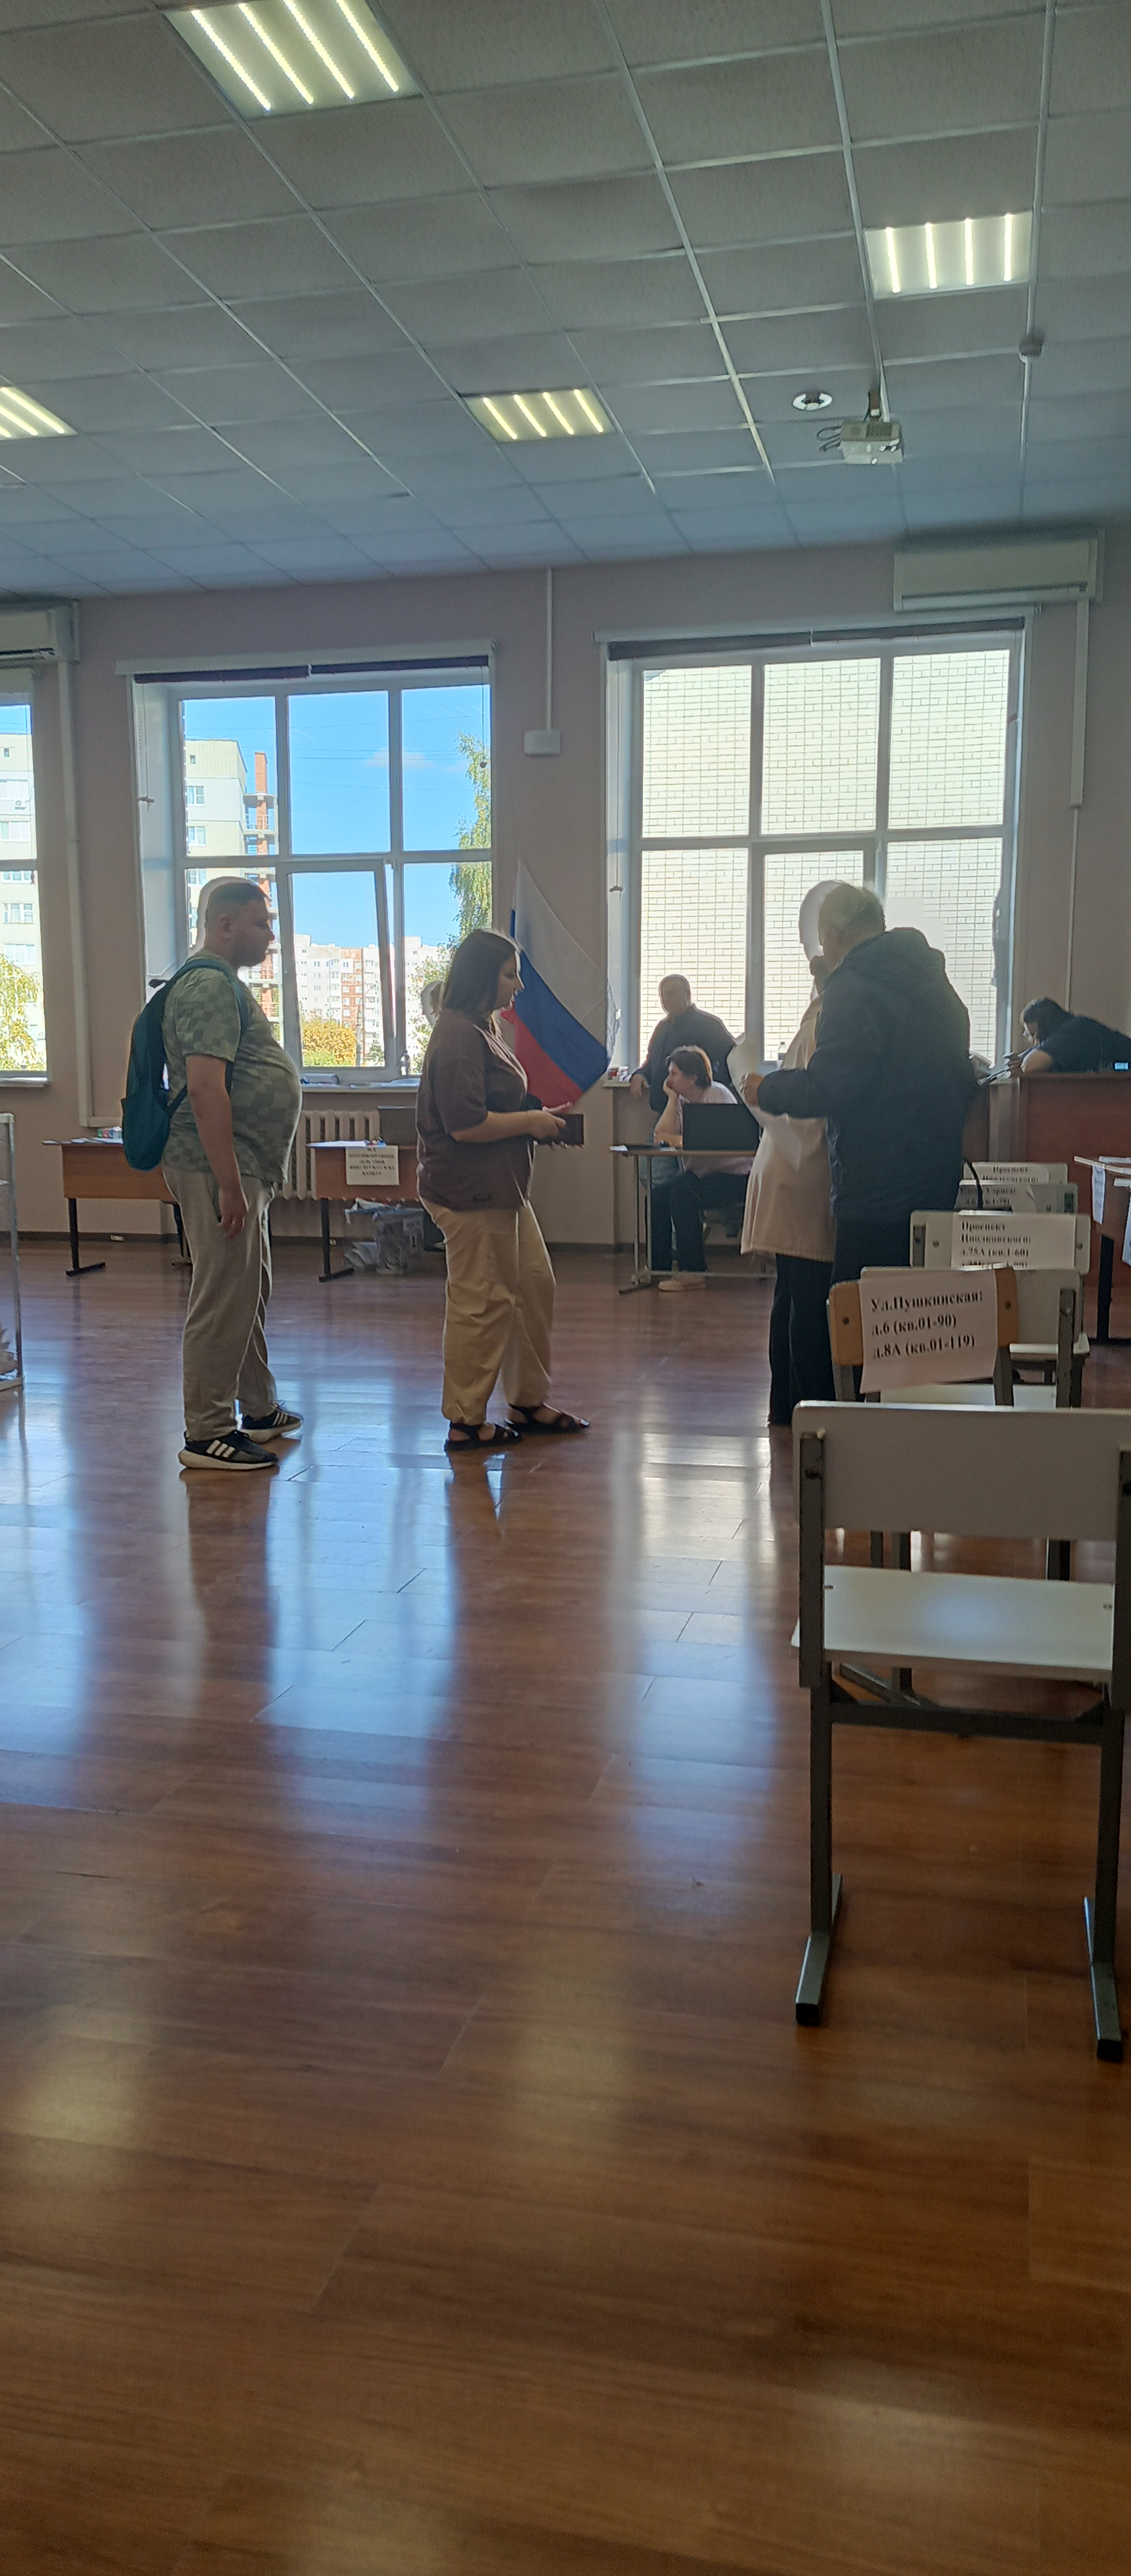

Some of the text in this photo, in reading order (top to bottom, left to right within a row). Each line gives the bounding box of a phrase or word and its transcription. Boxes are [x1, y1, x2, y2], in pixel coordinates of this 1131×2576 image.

[961, 1221, 1005, 1232] Проспект
[871, 1291, 983, 1313] Ул.Пушкинская:
[871, 1314, 957, 1336] д.6 (кв.01-90)
[872, 1334, 975, 1360] д.8А (кв.01-119)
